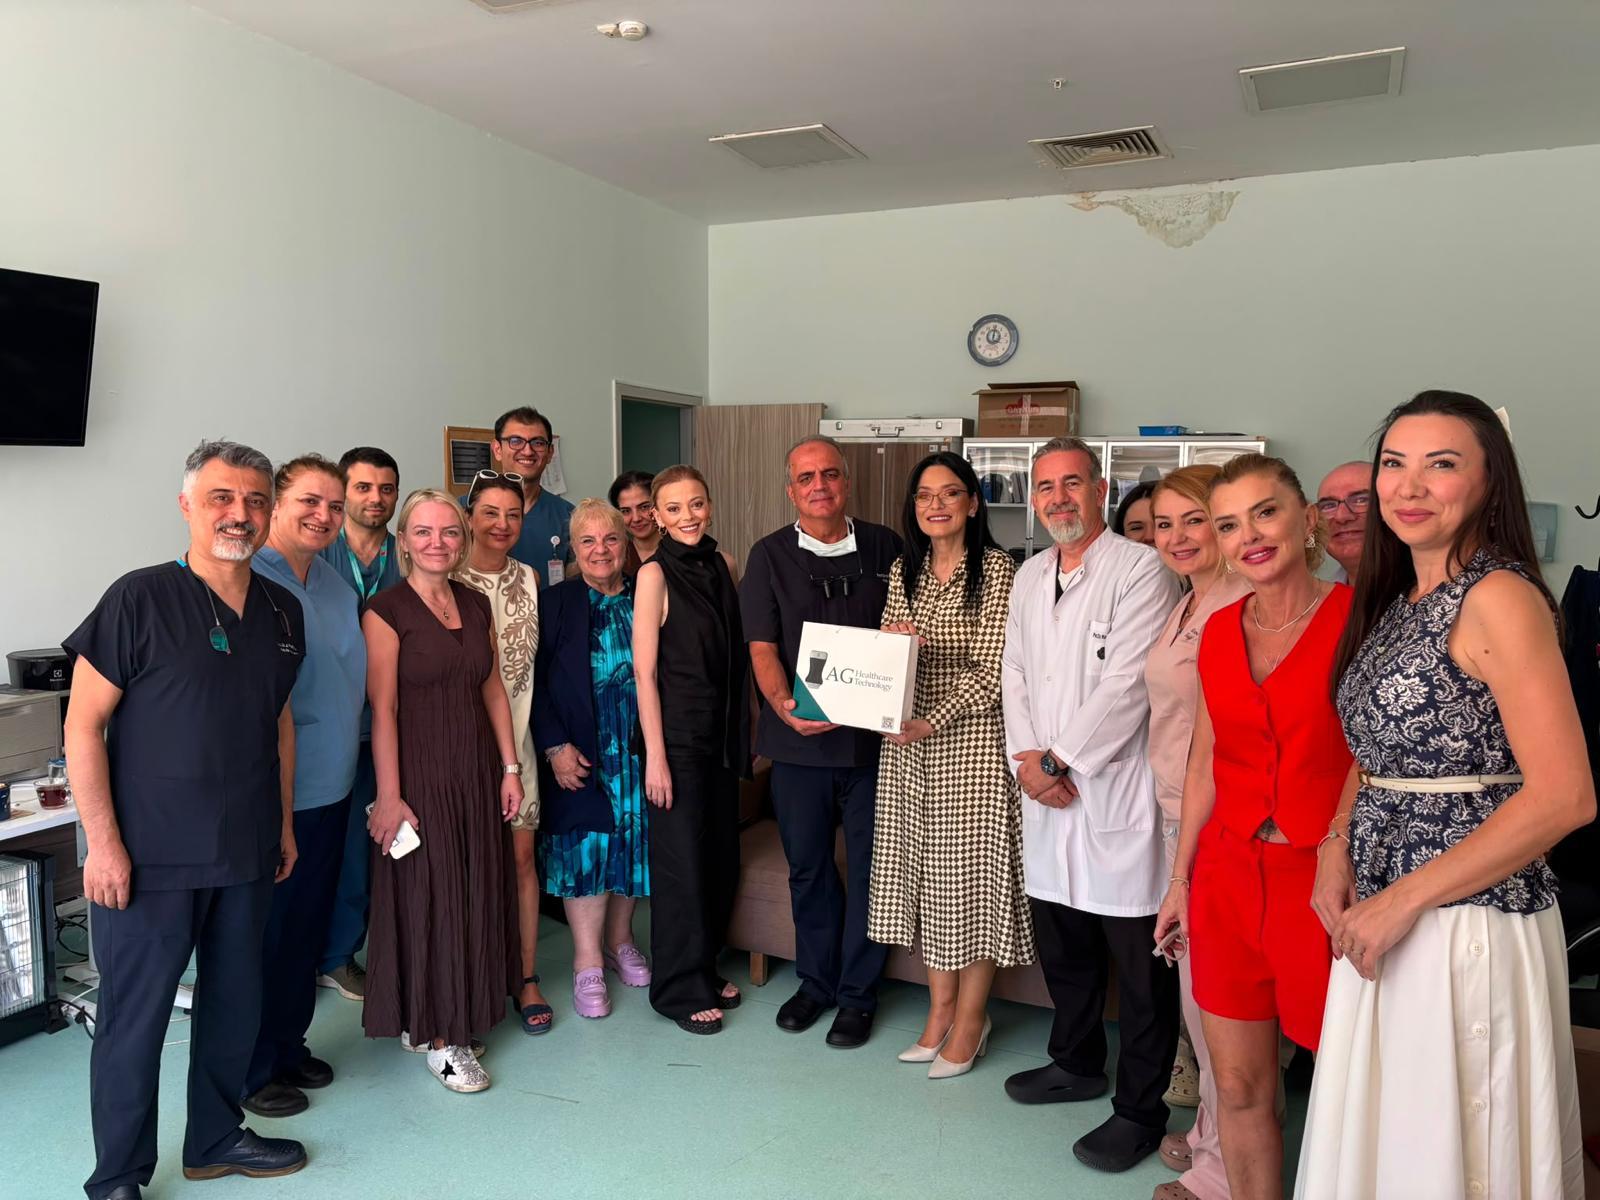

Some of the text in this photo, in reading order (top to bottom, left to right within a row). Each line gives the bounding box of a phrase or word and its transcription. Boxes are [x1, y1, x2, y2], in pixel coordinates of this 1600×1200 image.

[826, 667, 854, 684] AG
[855, 670, 894, 682] Healthcare
[855, 678, 893, 692] Technology
